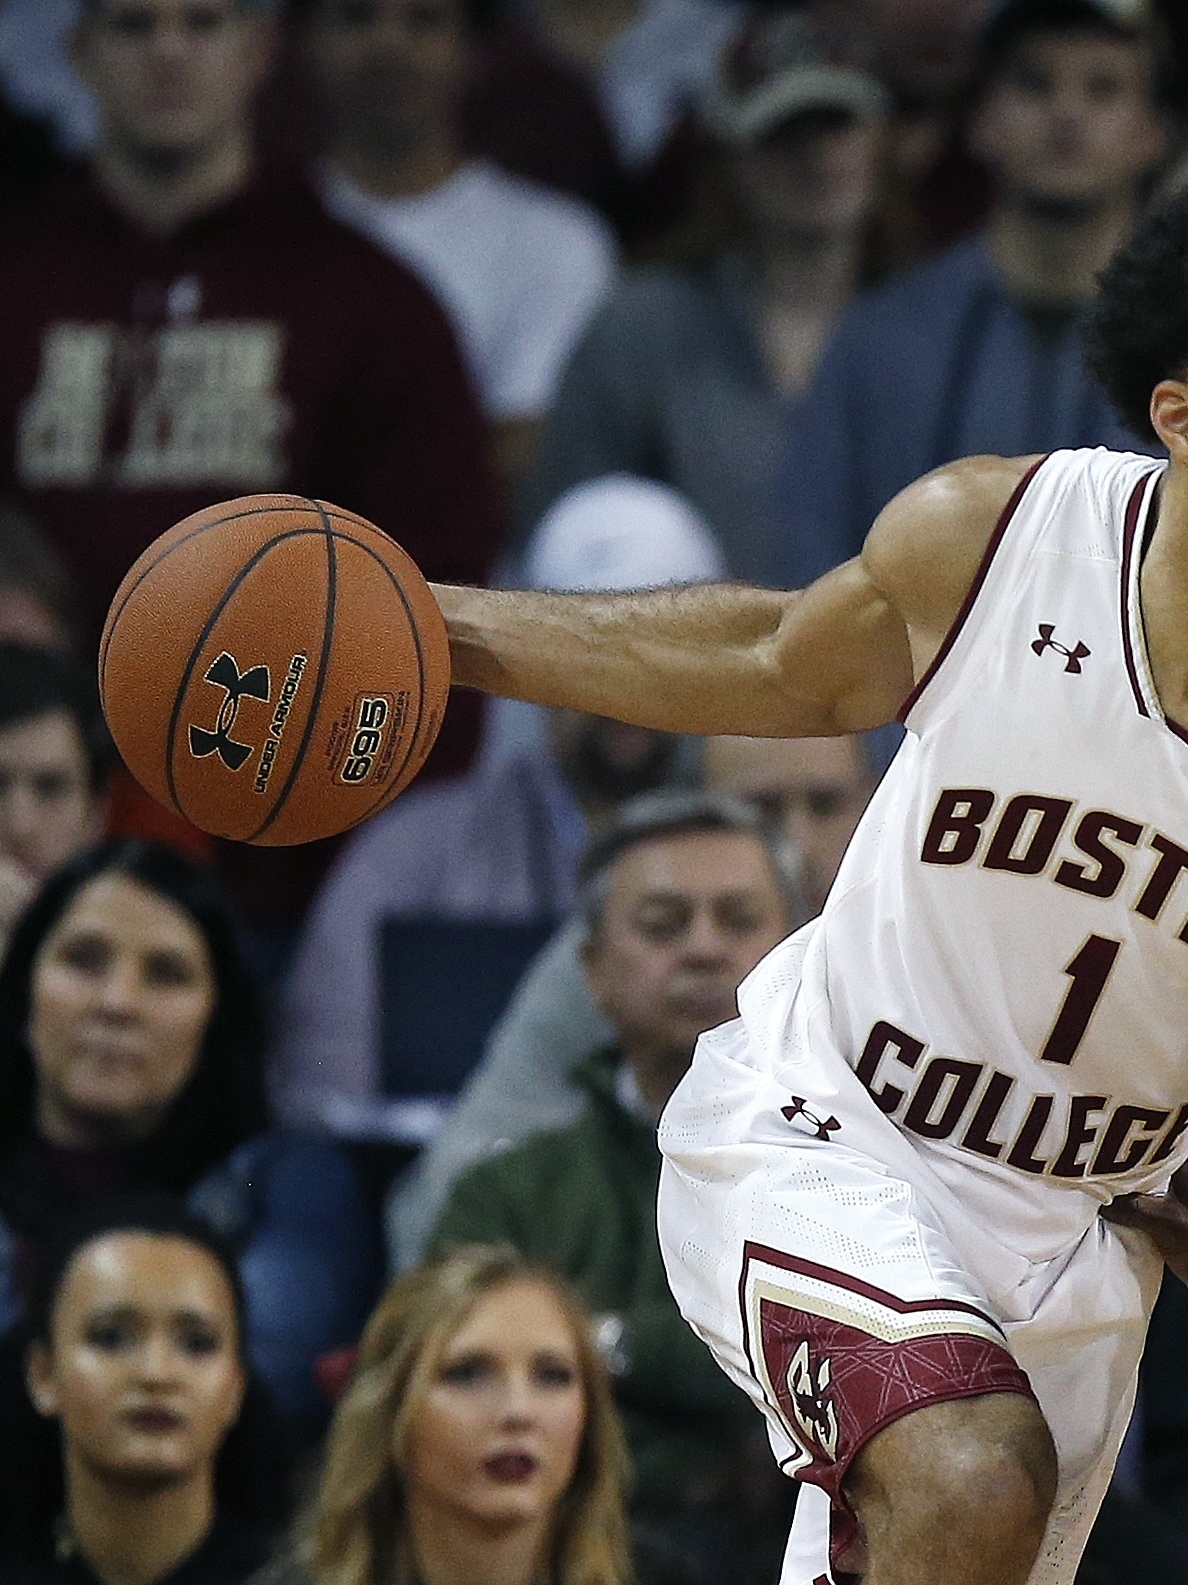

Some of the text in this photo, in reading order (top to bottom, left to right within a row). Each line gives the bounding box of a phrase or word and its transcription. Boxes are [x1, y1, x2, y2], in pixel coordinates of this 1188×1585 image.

[254, 654, 308, 794] UNDER ARMOUR
[341, 697, 388, 784] 695
[1040, 932, 1123, 1066] 1
